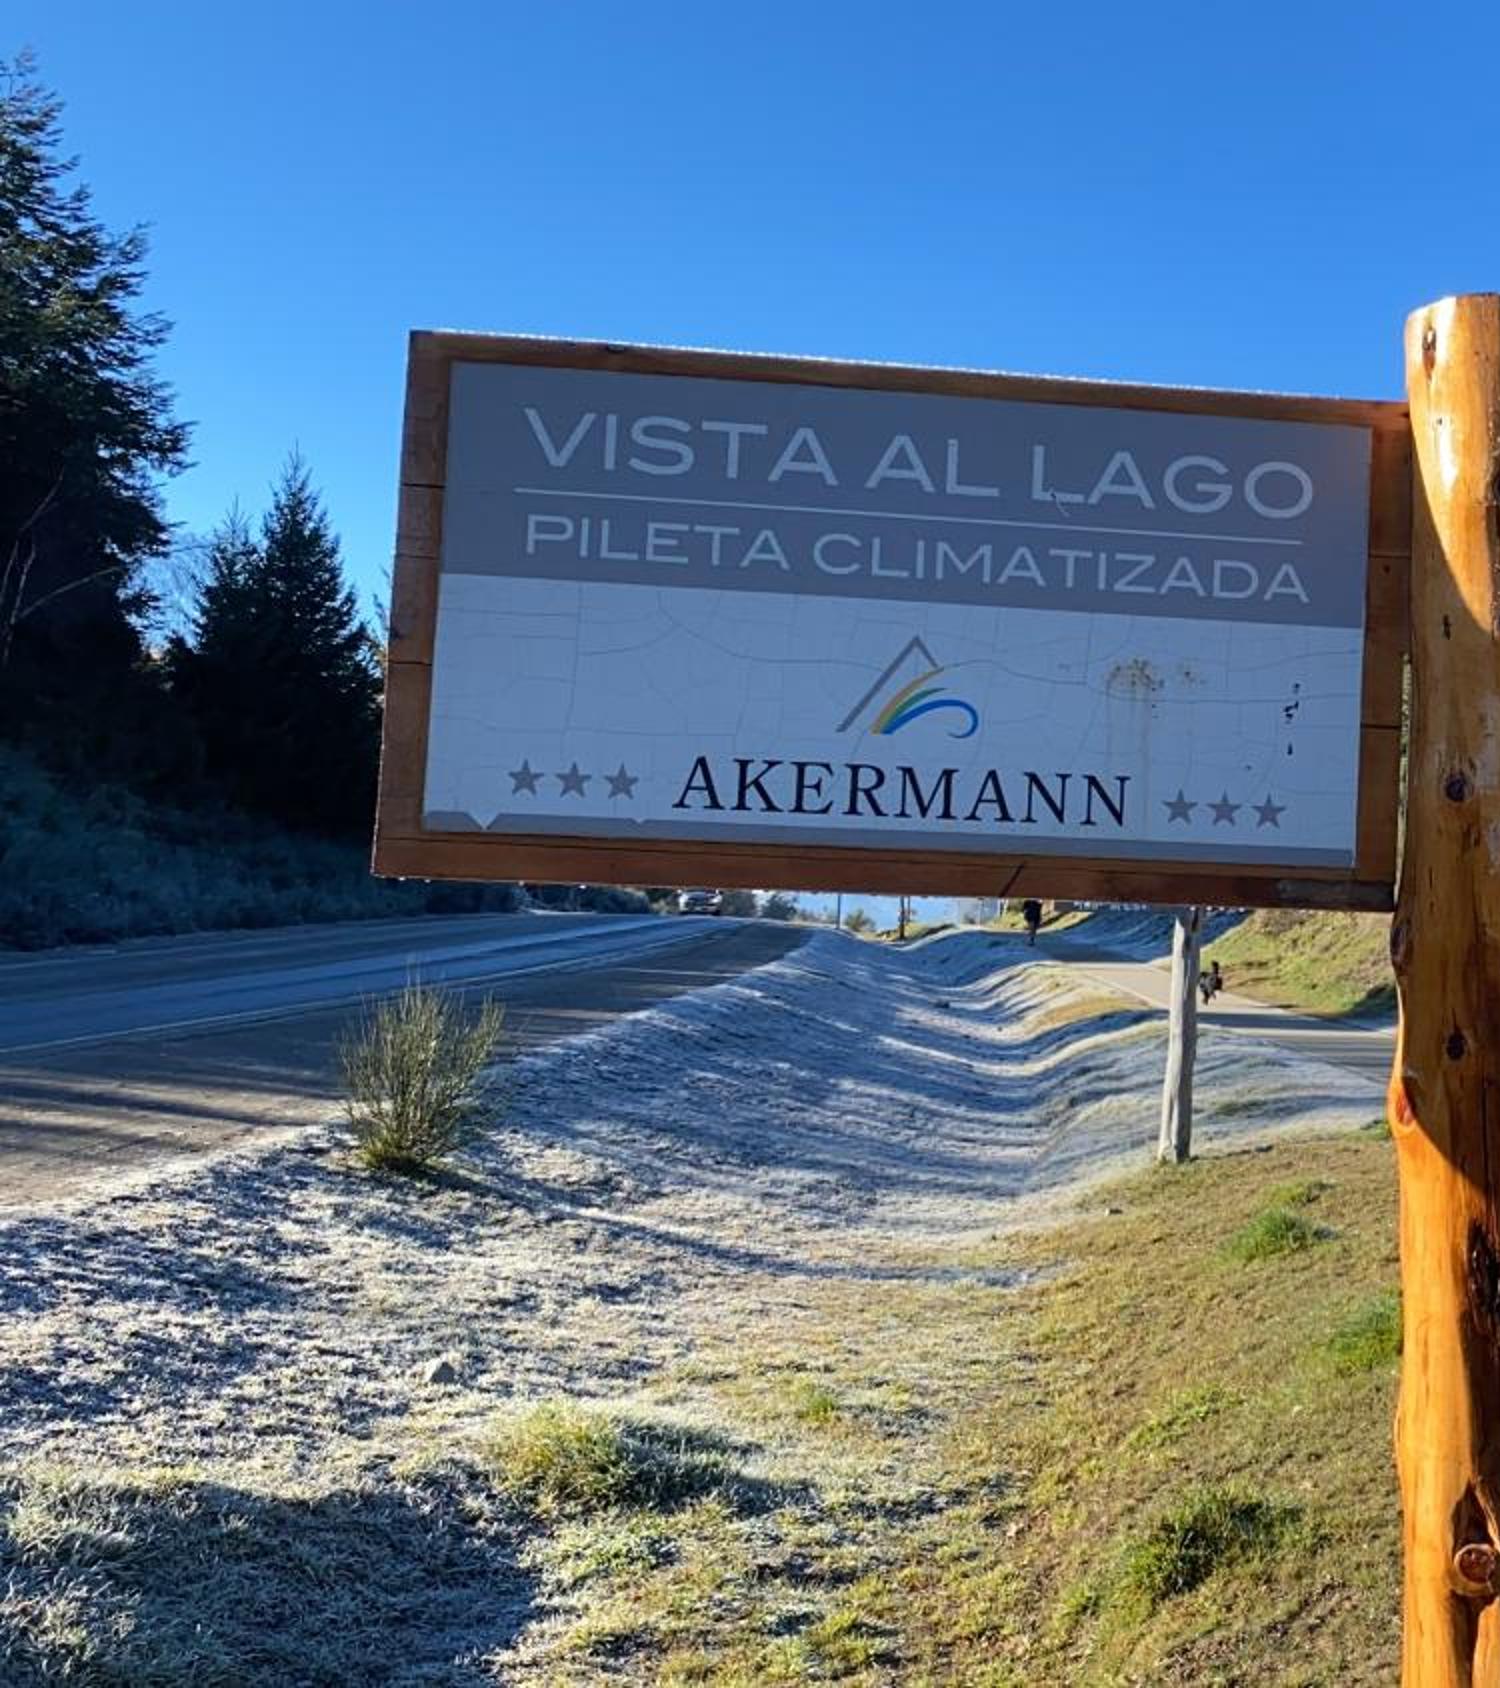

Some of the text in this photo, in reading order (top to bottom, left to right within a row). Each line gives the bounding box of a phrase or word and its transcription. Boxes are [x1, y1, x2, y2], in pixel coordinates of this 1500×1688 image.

[524, 408, 1313, 519] VISTA AL LAGO
[525, 514, 1310, 603] PILETA CLIMATIZADA
[672, 755, 1130, 827] AKERMANN
